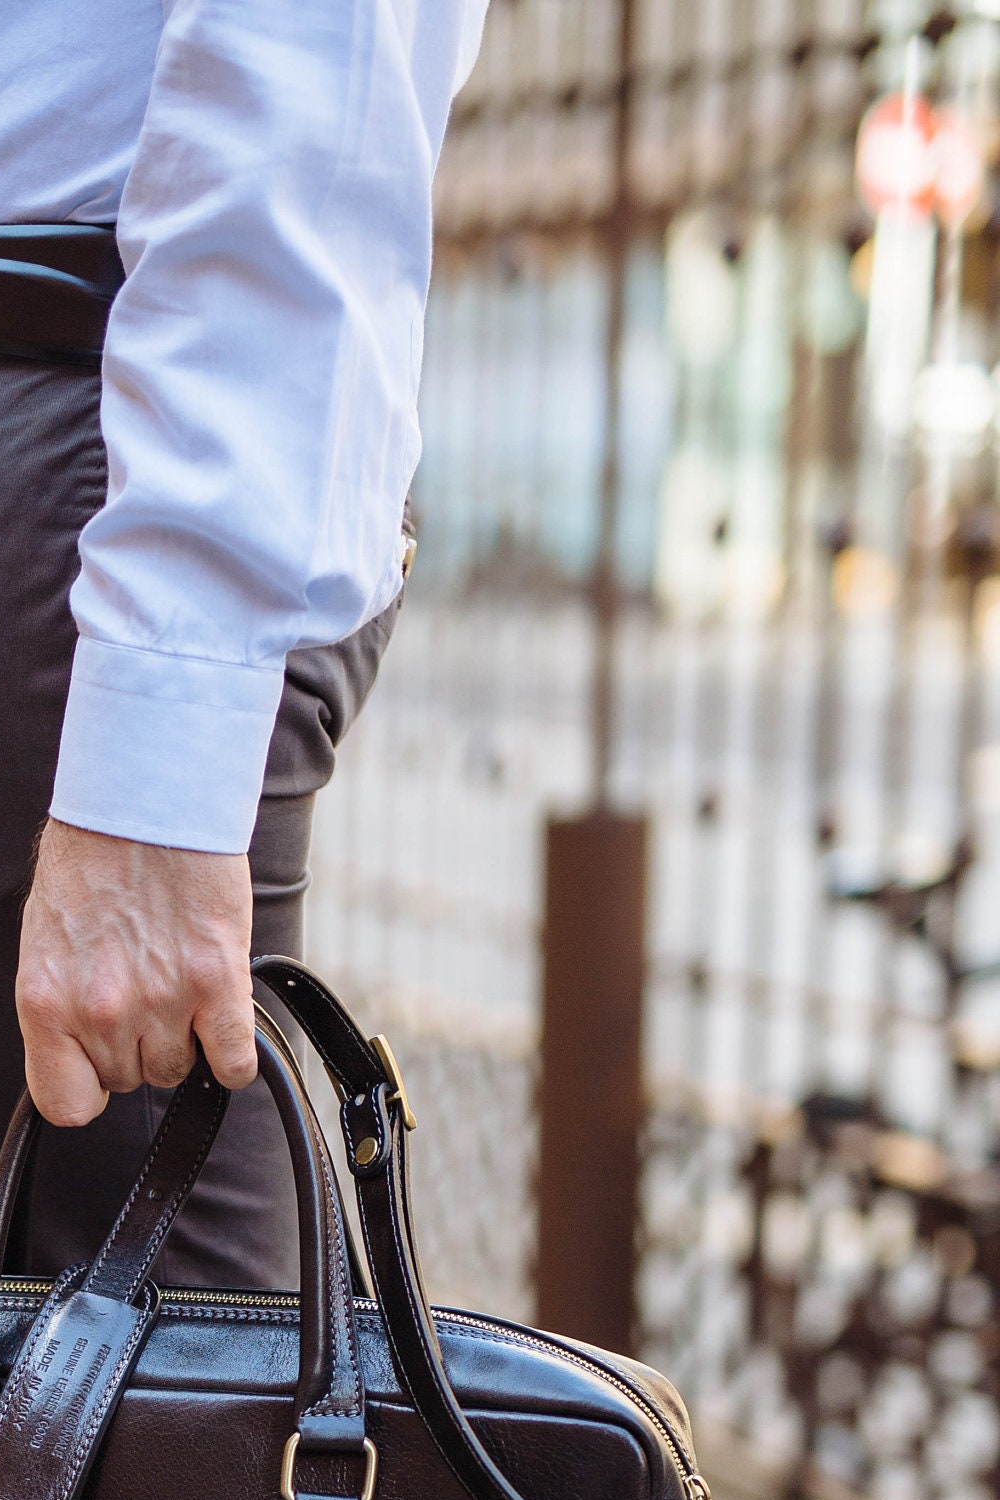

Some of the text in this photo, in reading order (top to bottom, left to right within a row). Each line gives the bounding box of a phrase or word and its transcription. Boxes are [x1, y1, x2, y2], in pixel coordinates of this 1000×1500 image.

[13, 1338, 61, 1431] MADE IN ITALY
[30, 1337, 89, 1449] GENUINE LEATHER GOOD
